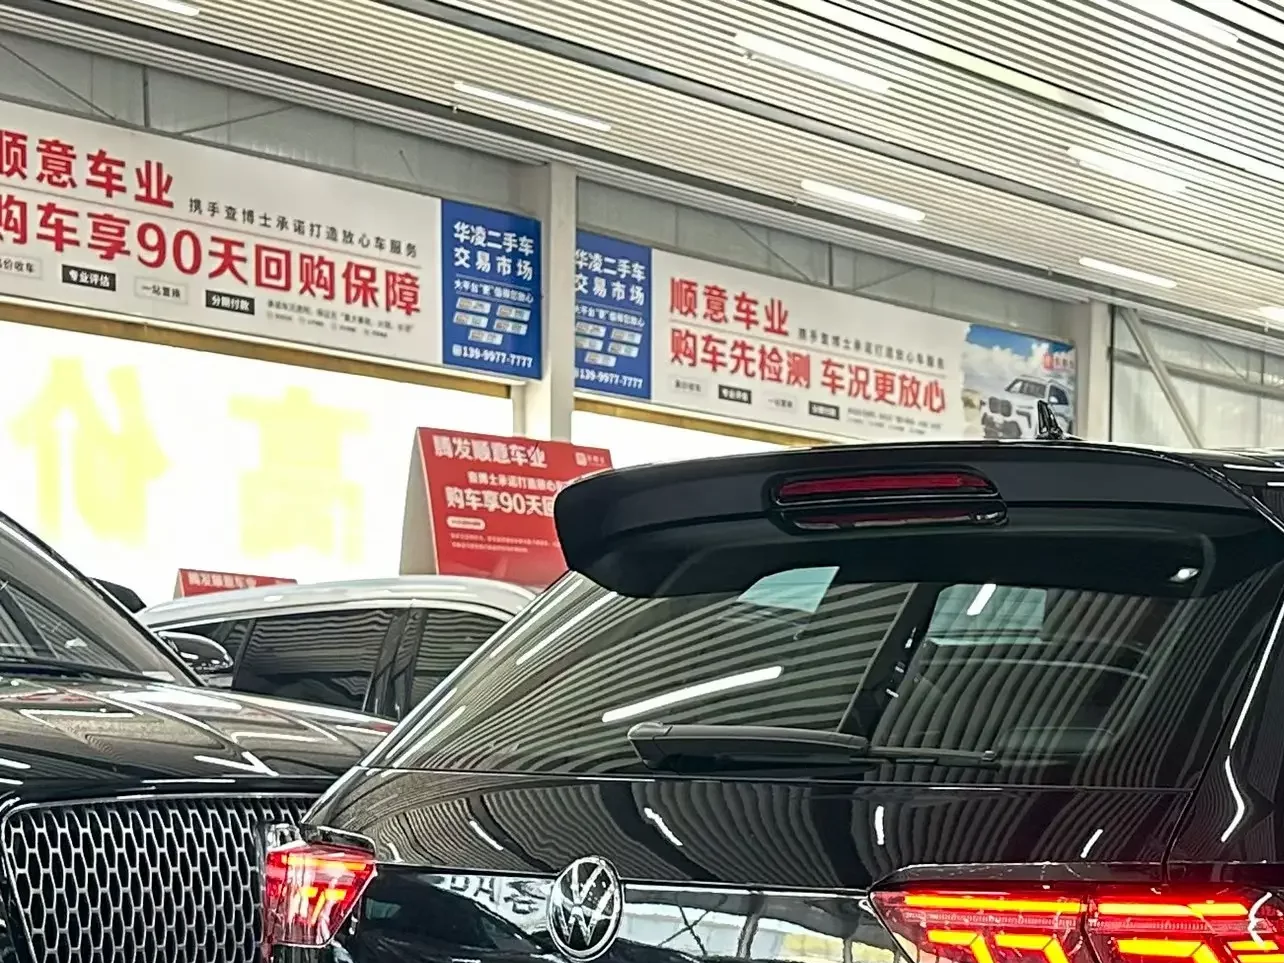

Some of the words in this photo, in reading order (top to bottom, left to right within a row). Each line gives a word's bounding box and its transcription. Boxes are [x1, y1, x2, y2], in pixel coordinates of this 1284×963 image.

[188, 197, 418, 259] 携手查博士承诺打造放心车服务
[453, 220, 534, 257] 华凌二手车
[0, 193, 421, 317] 购车享90天回购保障
[453, 247, 533, 281] 交易市场
[575, 249, 646, 282] 华凌二手车
[575, 274, 646, 307] 交易市场
[669, 277, 790, 337] 顺意车业
[671, 328, 811, 389] 购车先检测
[821, 358, 946, 414] 车况更放心
